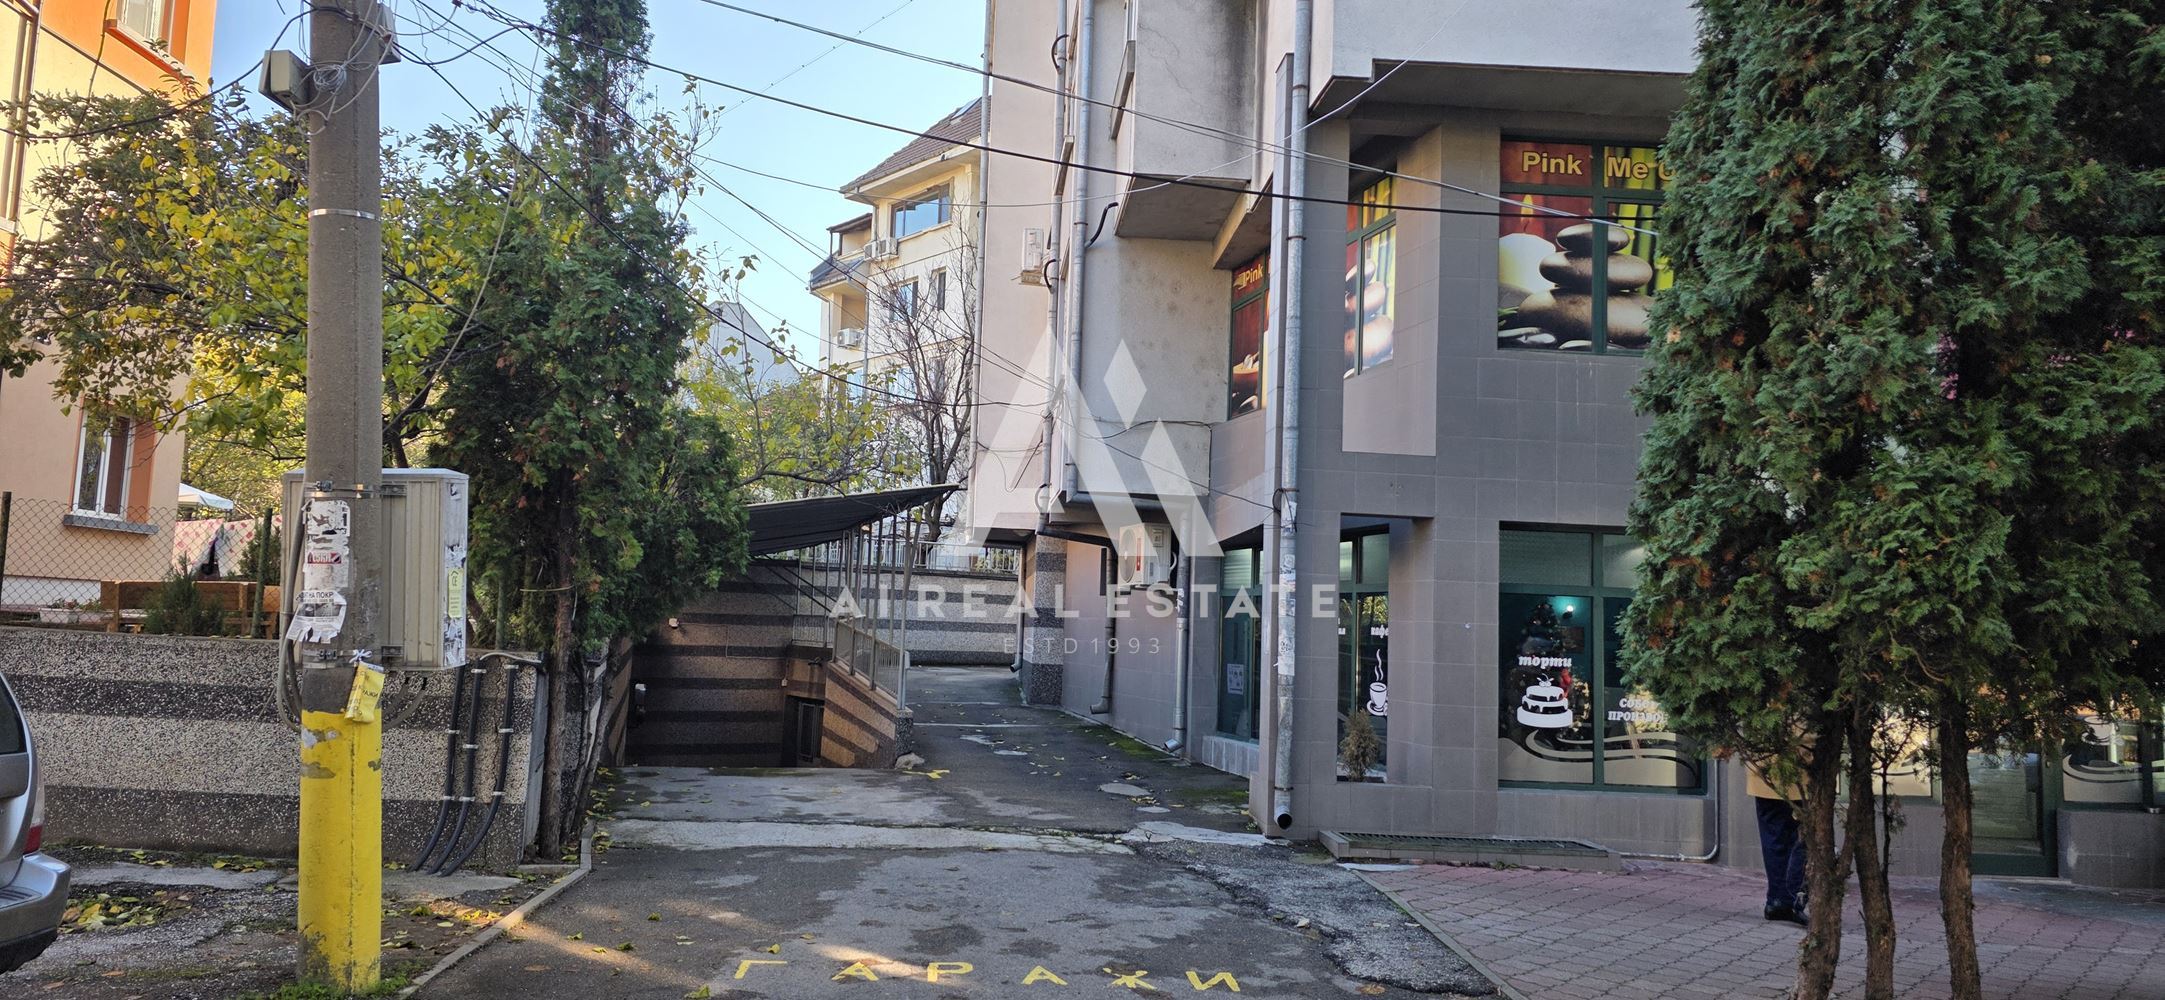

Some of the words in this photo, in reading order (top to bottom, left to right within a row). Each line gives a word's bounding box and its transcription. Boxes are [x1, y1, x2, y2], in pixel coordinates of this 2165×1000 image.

[1522, 151, 1583, 176] Pink
[1607, 156, 1649, 180] Me
[1243, 263, 1264, 284] Pink
[1518, 655, 1573, 668] торти
[734, 960, 1241, 992] ГАРАЖИ
